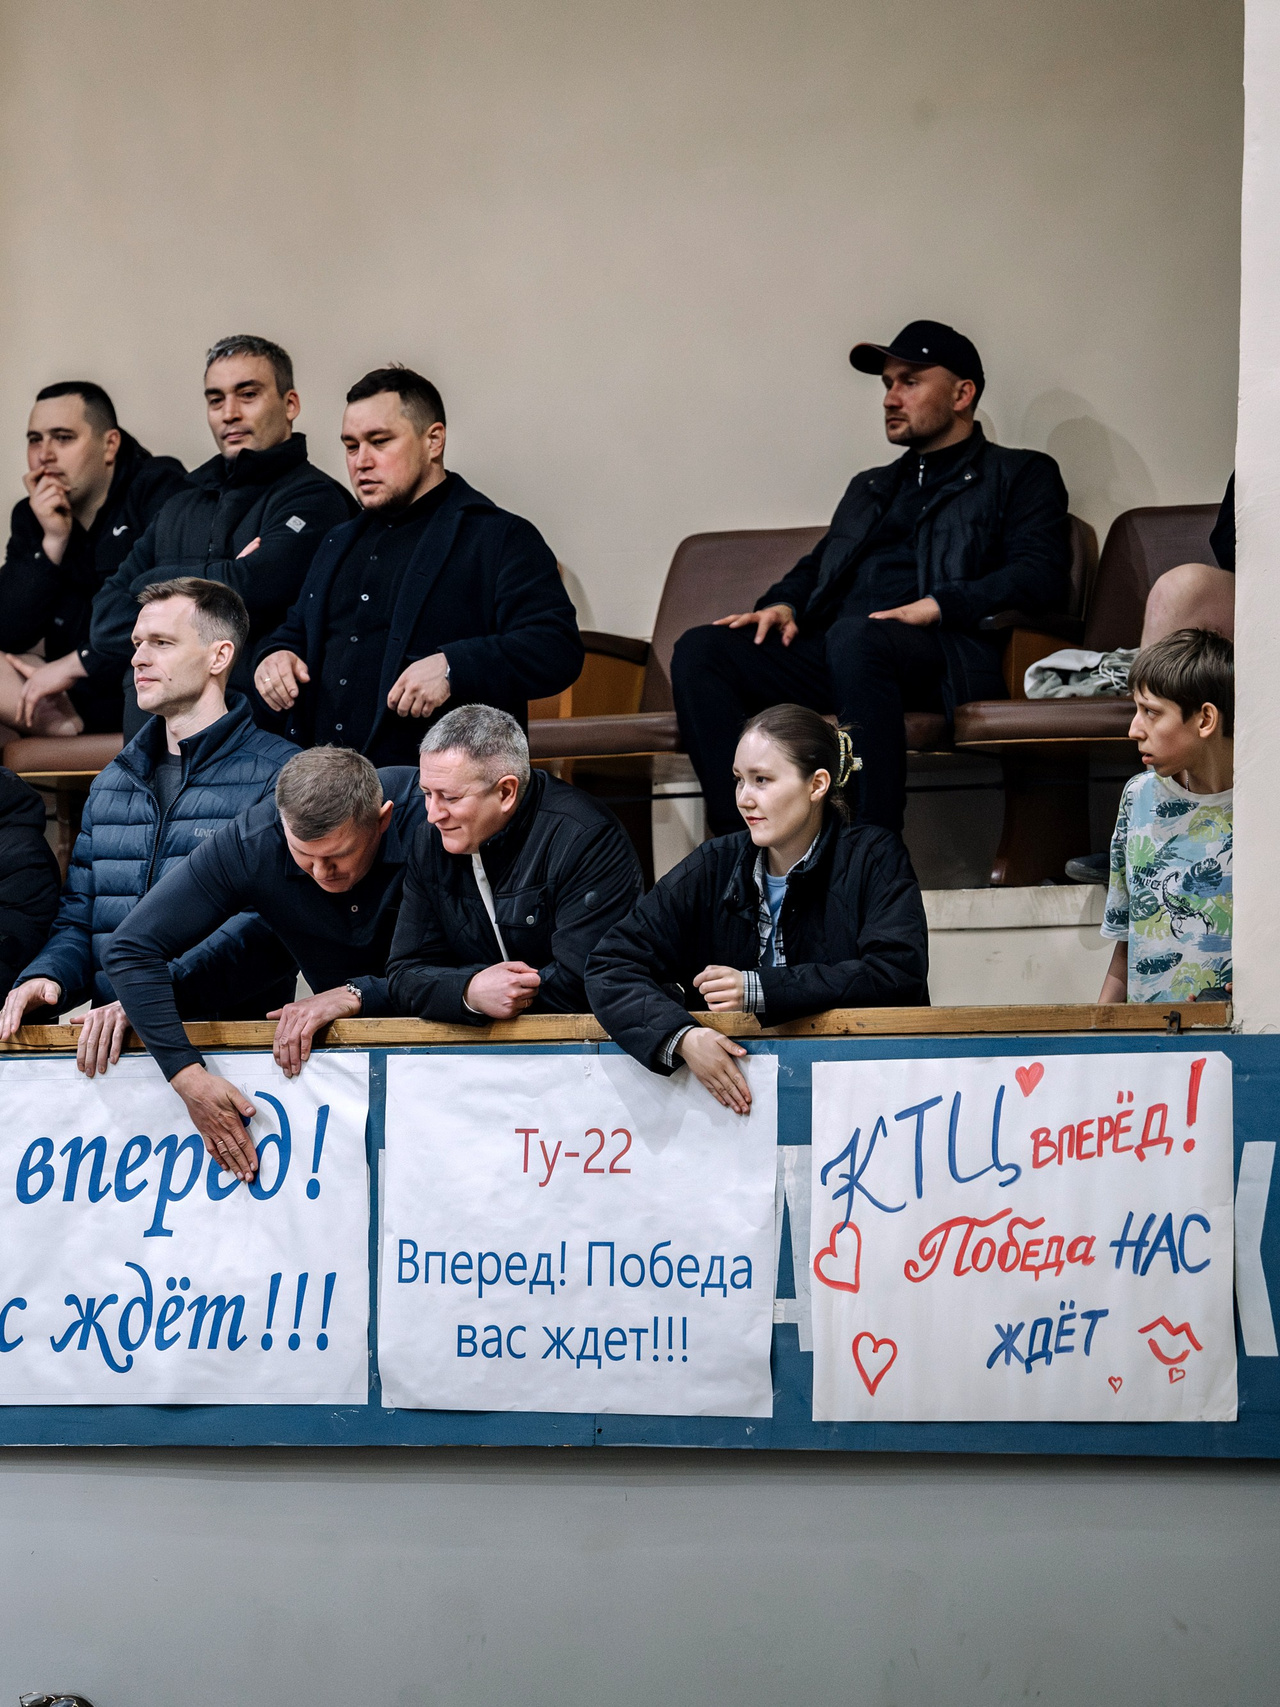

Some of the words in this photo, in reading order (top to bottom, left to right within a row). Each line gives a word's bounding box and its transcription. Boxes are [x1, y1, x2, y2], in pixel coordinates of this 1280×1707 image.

[515, 1128, 631, 1187] Ту-22
[821, 1085, 1021, 1233] КТЦ
[398, 1239, 566, 1298] Вперед!
[587, 1240, 753, 1298] Победа
[1110, 1211, 1211, 1276] НАС
[50, 1262, 336, 1373] ждёт!!!
[457, 1325, 526, 1359] вас
[542, 1316, 688, 1369] ждет!!!
[987, 1300, 1109, 1374] ЖДЁТ
